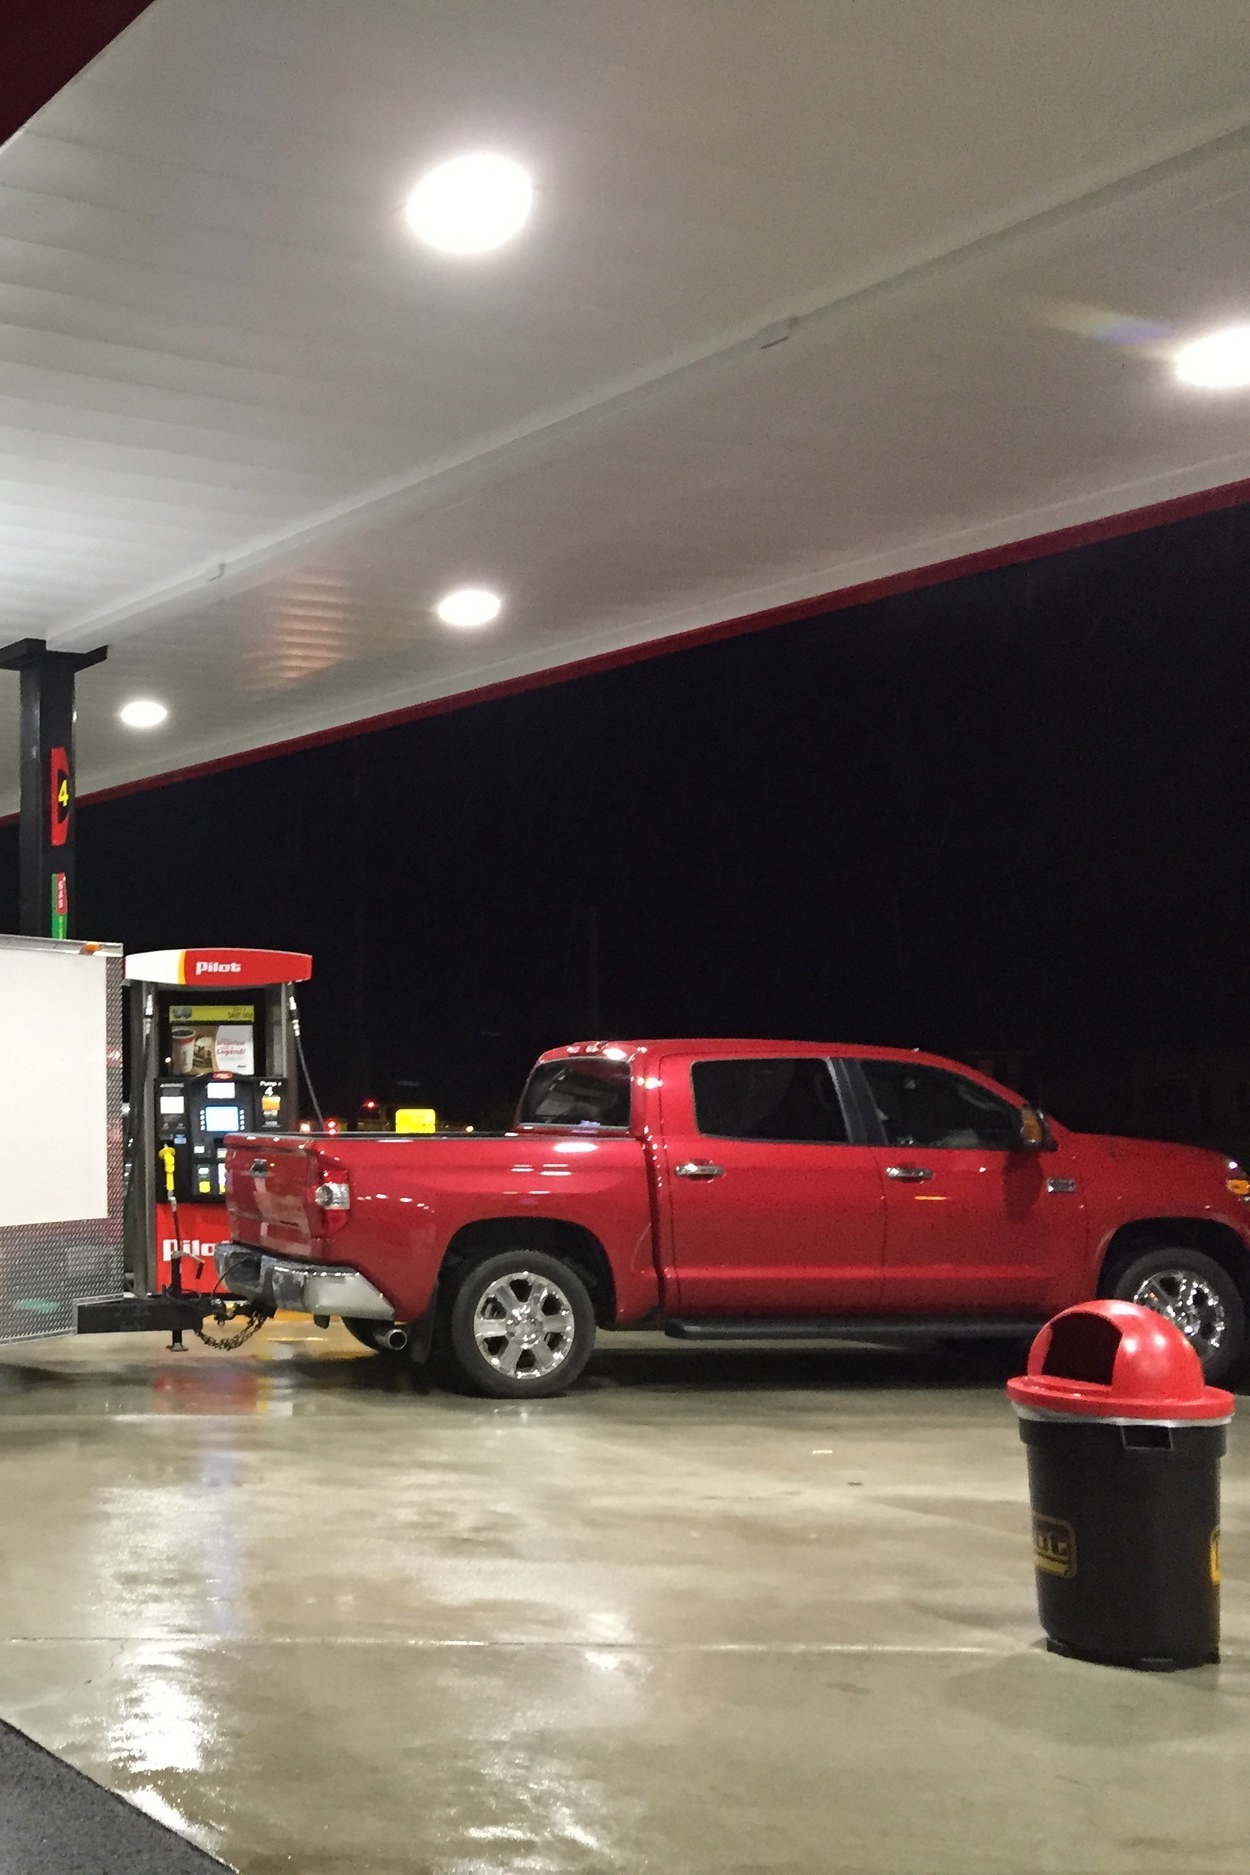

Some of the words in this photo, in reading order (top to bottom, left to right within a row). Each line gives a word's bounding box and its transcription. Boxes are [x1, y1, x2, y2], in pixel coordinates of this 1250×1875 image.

[58, 779, 69, 807] 4
[195, 961, 242, 976] Pilot
[264, 1086, 274, 1097] 4
[162, 1238, 230, 1262] Pilo
